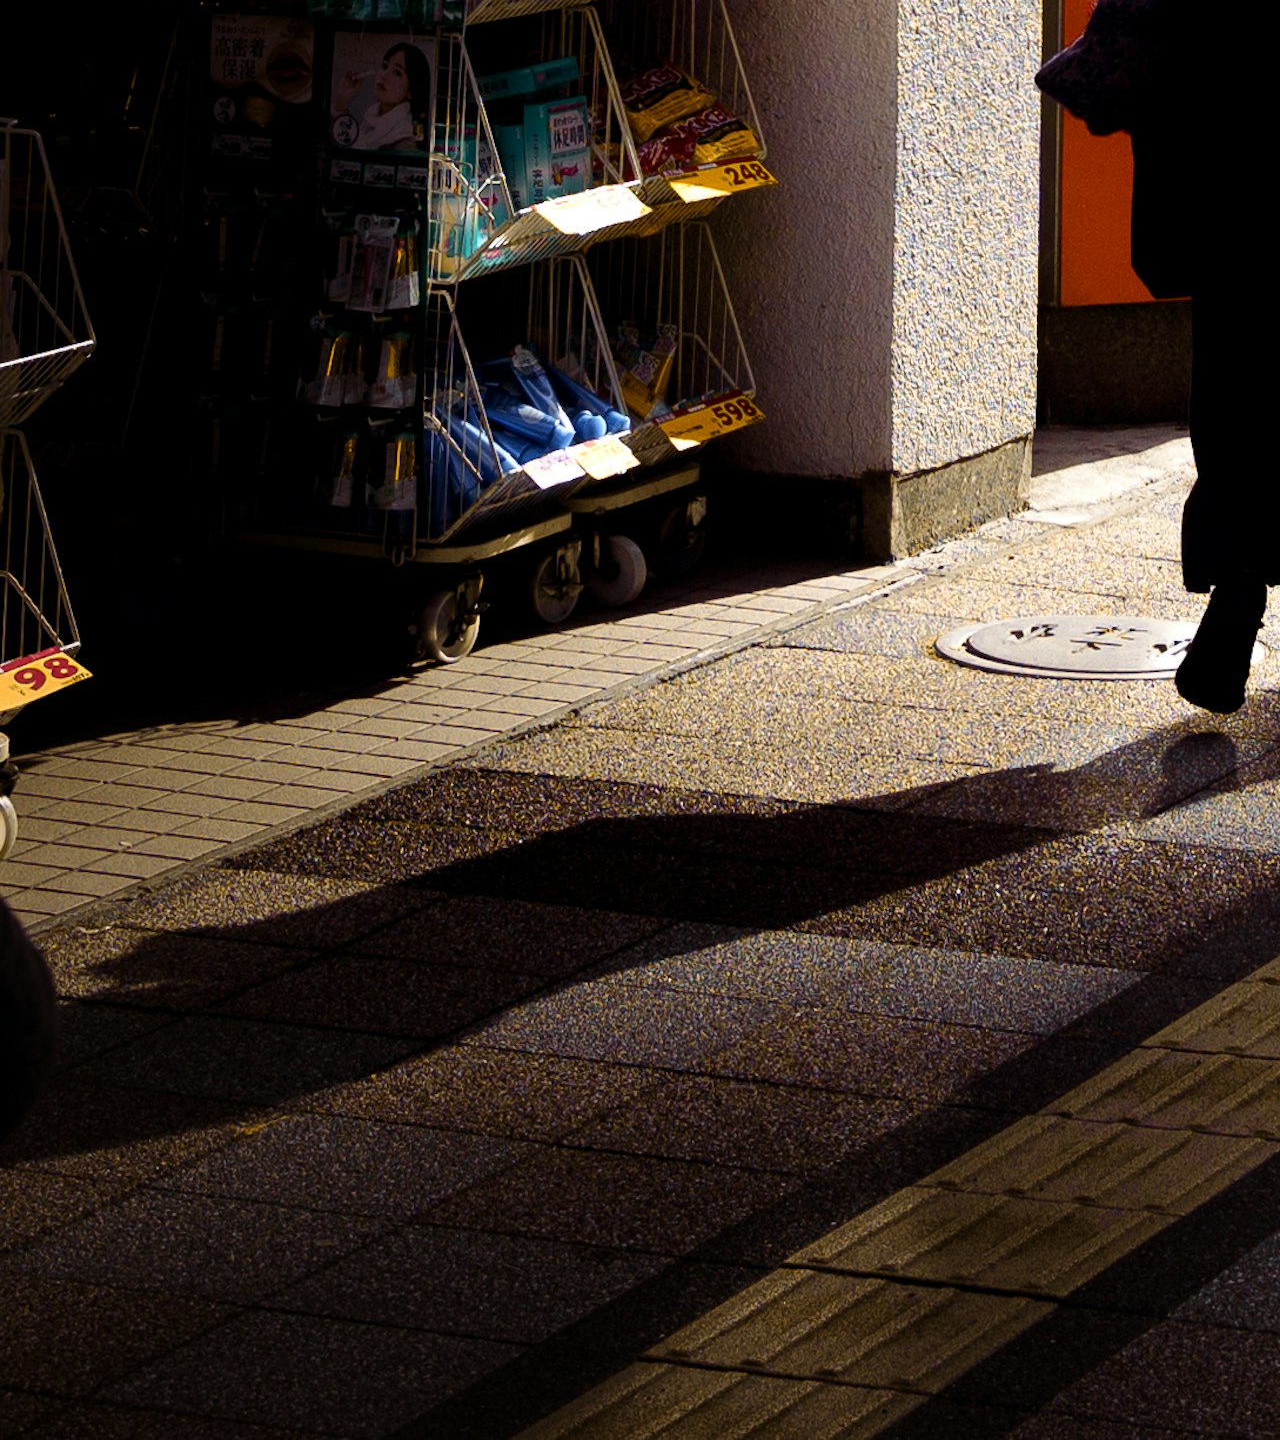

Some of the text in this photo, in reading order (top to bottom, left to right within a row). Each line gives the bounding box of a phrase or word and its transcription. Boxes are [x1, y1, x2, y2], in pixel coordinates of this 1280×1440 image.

[215, 37, 266, 58] 高密着
[222, 59, 257, 81] 保湿
[724, 163, 770, 184] 248
[712, 399, 757, 426] 598
